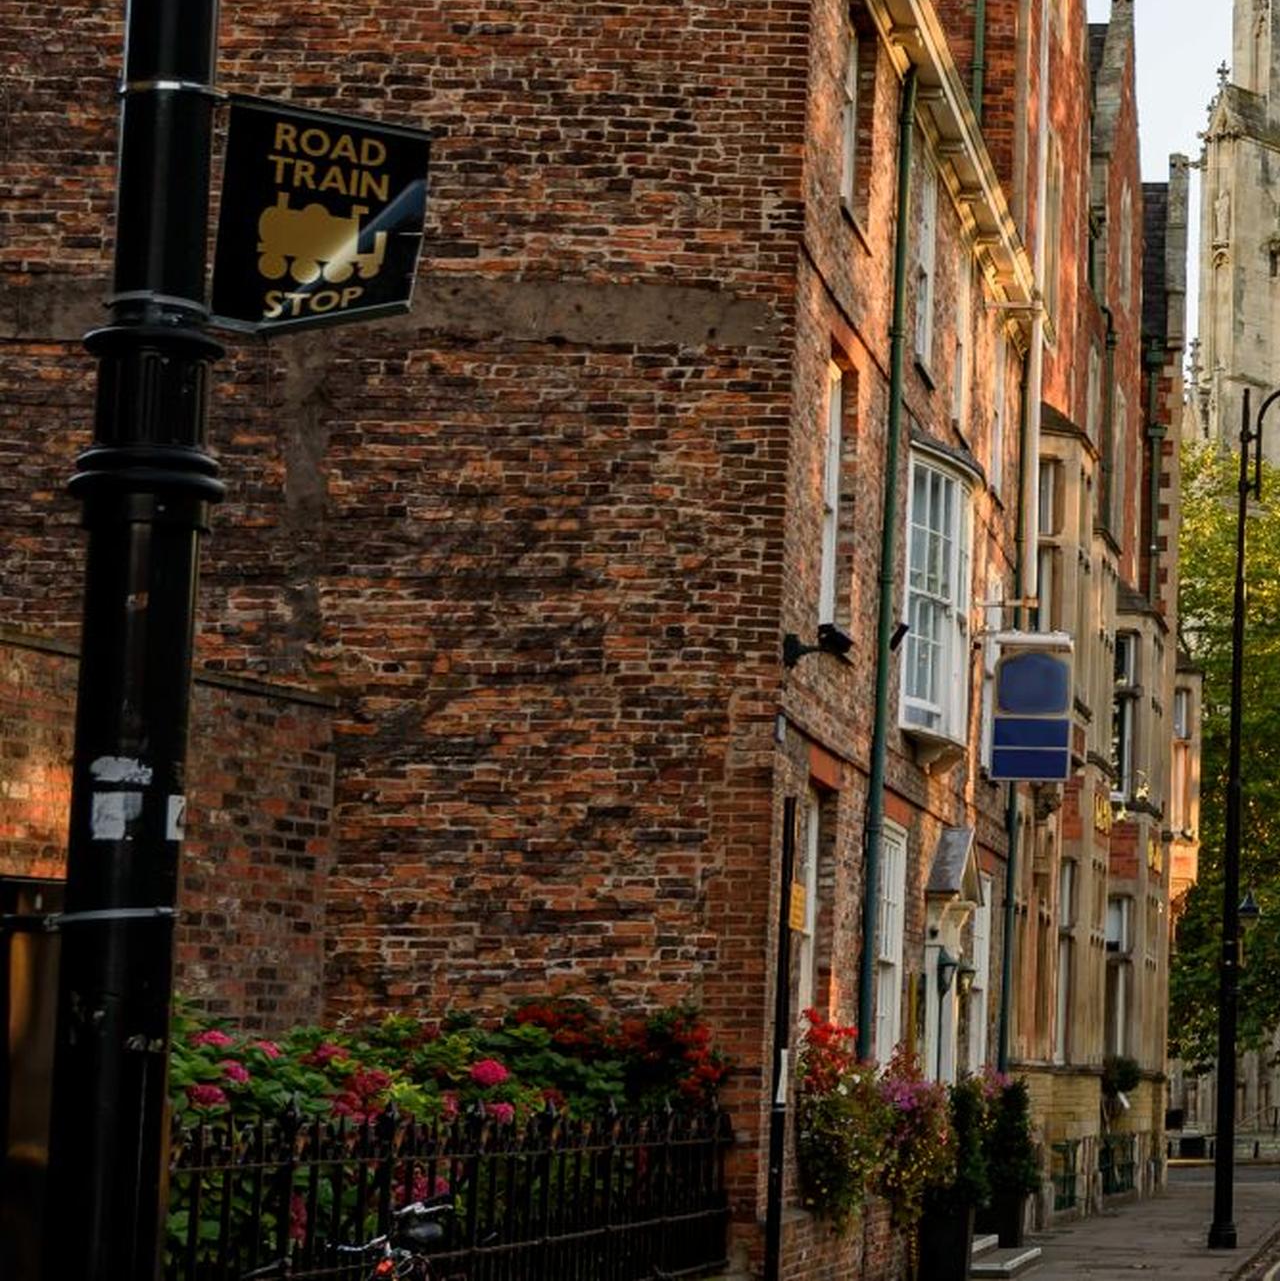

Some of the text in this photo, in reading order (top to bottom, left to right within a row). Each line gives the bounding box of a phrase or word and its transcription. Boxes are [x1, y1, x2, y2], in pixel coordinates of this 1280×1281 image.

[274, 122, 387, 166] ROAD
[267, 154, 390, 202] TRAIN
[263, 286, 364, 318] STOP
